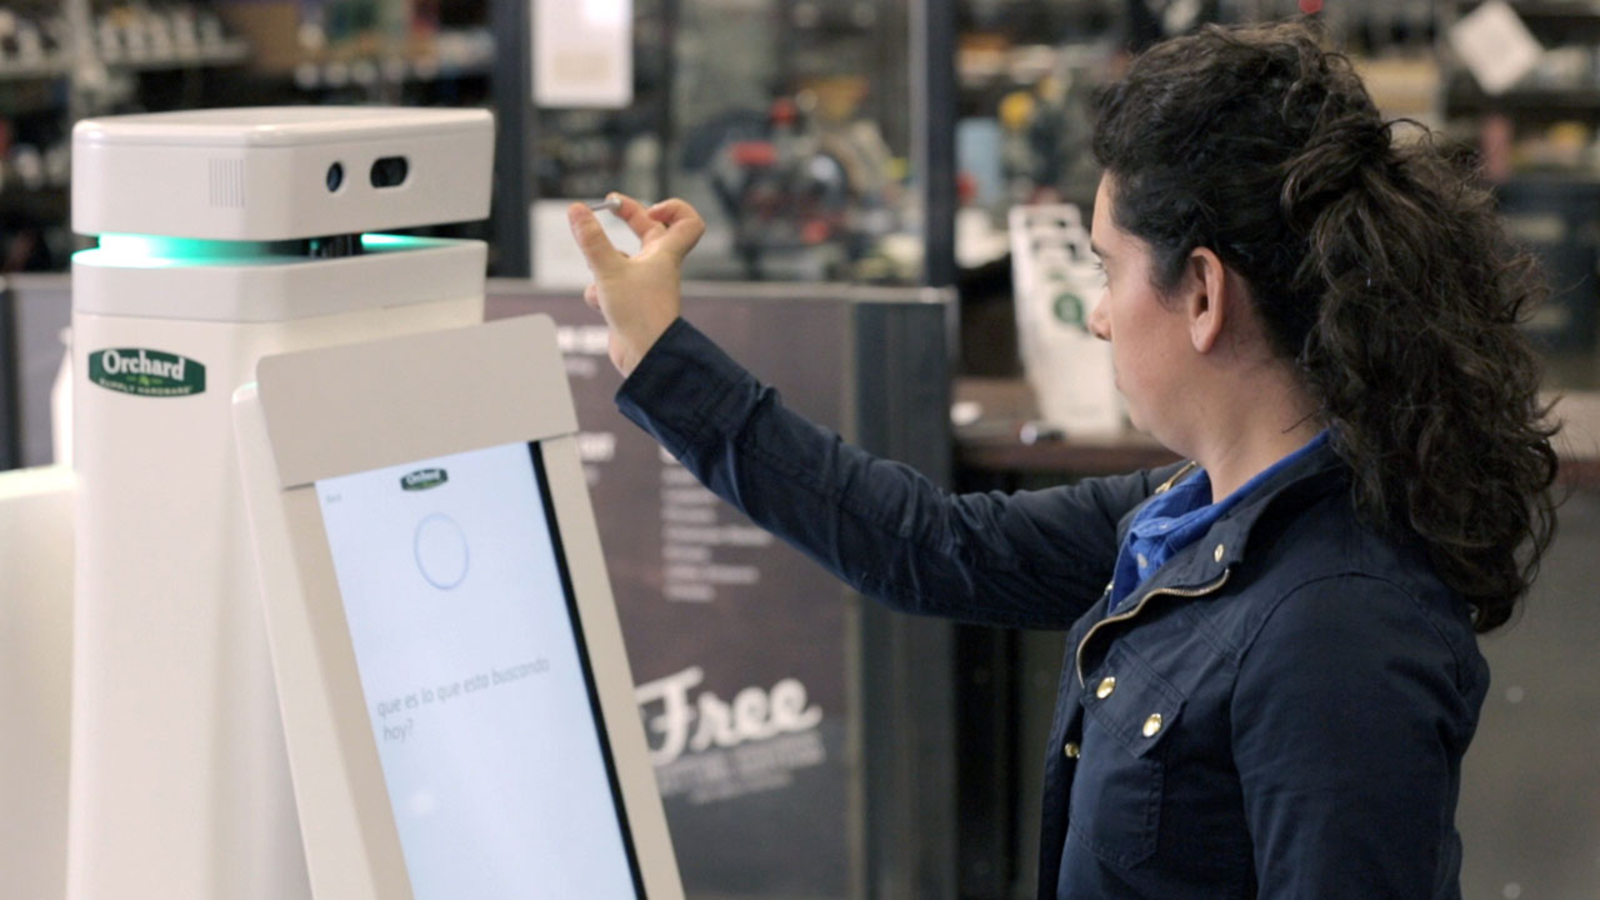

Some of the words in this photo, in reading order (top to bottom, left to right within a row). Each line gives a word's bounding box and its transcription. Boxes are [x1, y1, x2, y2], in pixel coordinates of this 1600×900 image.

[102, 350, 185, 381] Orchard
[377, 698, 401, 718] que
[404, 693, 419, 709] es
[421, 687, 434, 704] lo
[437, 682, 461, 703] que
[492, 656, 551, 686] buscando
[383, 717, 414, 743] hoy?
[635, 666, 823, 767] Free
